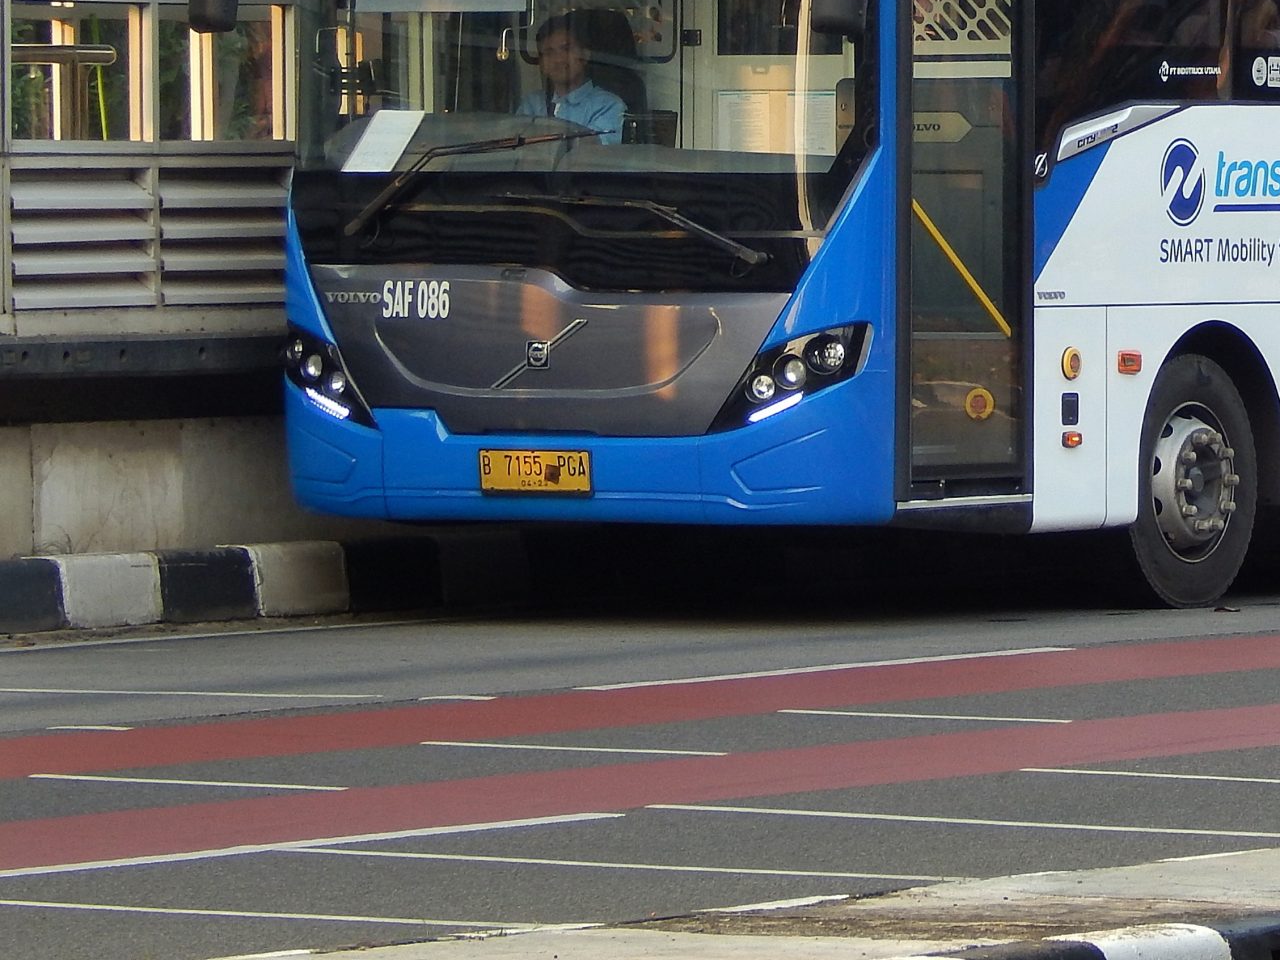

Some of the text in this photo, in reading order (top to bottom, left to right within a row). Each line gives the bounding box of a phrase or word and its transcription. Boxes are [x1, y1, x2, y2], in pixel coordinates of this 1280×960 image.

[1159, 238, 1213, 263] SMART
[1217, 238, 1276, 267] Mobility
[326, 280, 450, 319] VOLVO SAF 086
[482, 455, 586, 477] B 7155 PGA
